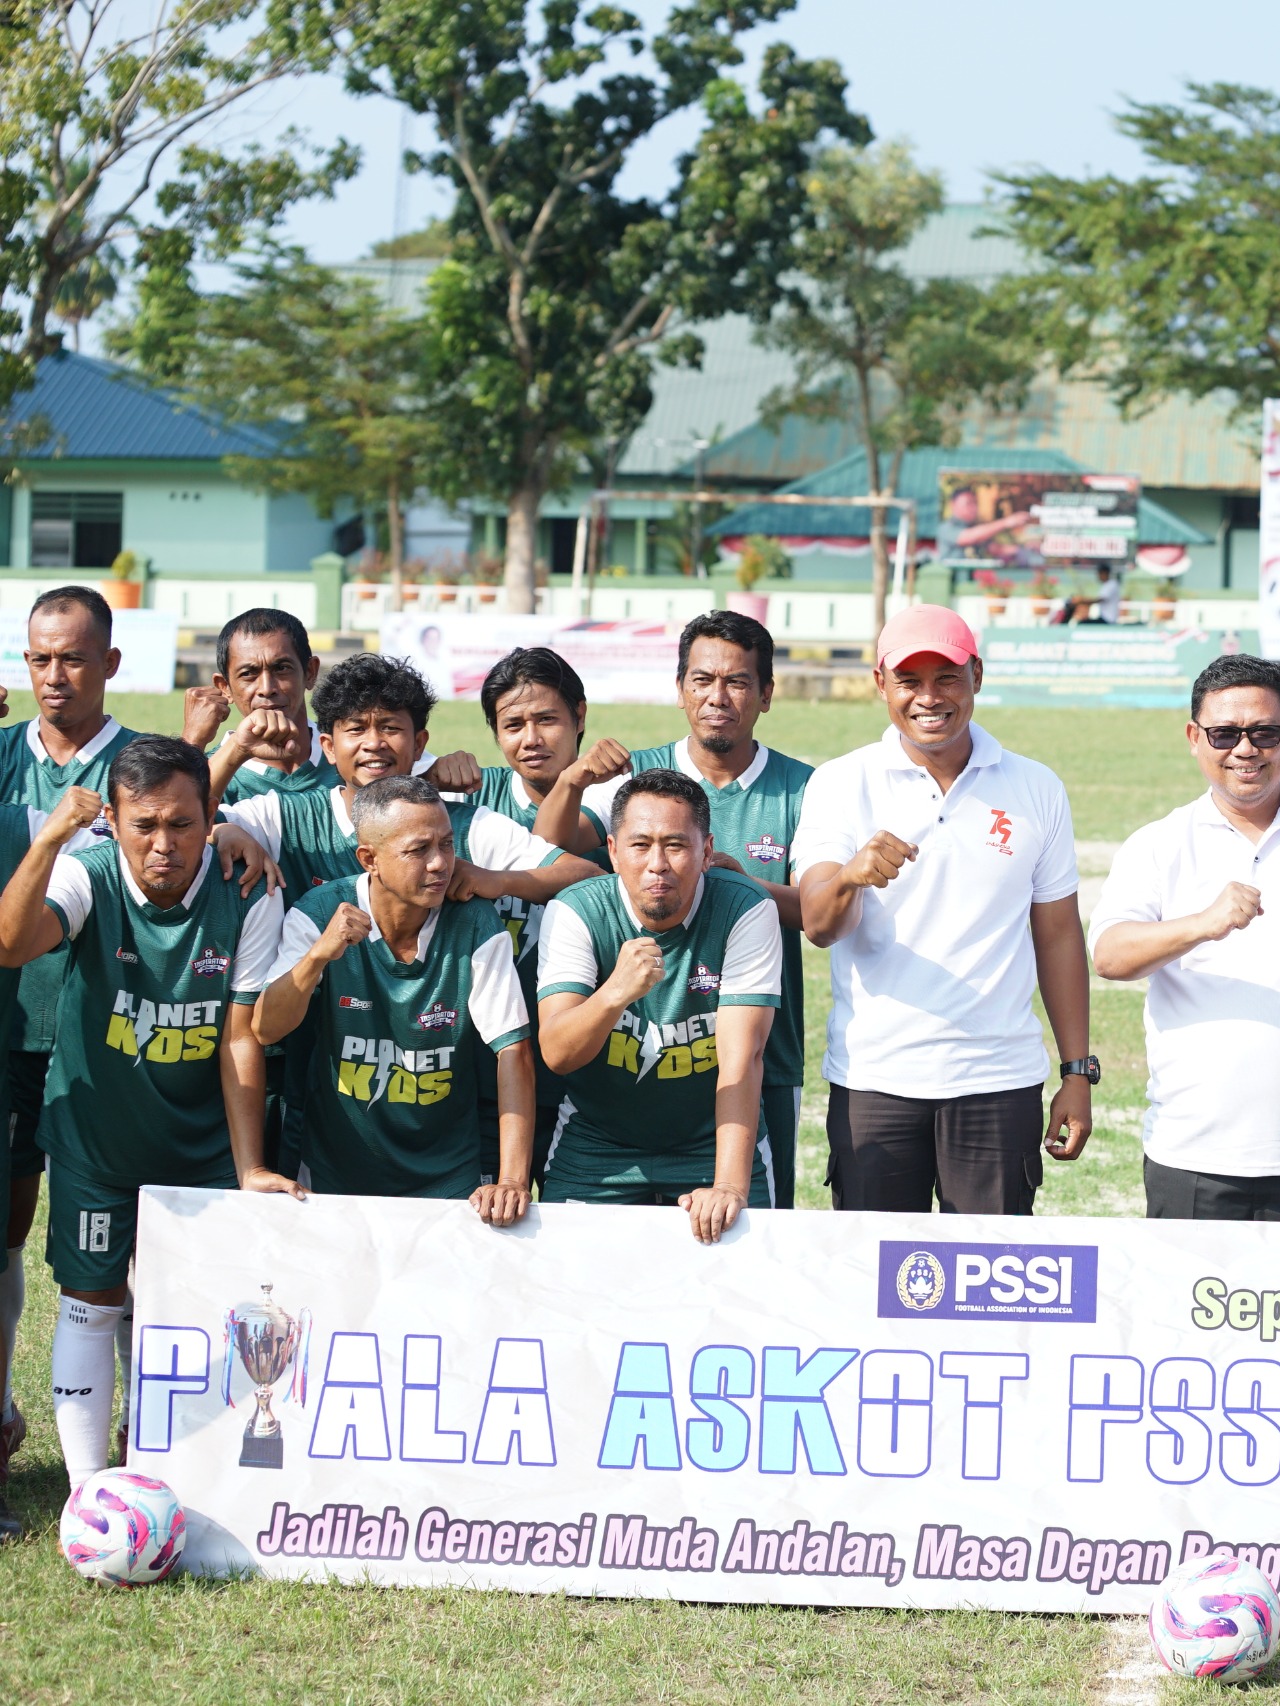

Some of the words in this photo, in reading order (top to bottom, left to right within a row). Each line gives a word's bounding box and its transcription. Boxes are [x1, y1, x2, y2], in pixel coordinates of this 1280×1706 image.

[341, 1035, 456, 1071] PLANET
[79, 1211, 111, 1252] 18
[954, 1253, 1073, 1305] PSSI
[954, 1304, 986, 1313] FOOTBALL
[986, 1305, 1028, 1314] ASSOCIATION
[1029, 1306, 1038, 1314] OF
[1038, 1307, 1073, 1315] INDONESIA
[135, 1324, 558, 1467] PALA
[596, 1341, 1030, 1481] ASKOT
[257, 1501, 409, 1560] Jadilah
[417, 1505, 597, 1567] Generasi
[598, 1514, 720, 1573] Muda
[724, 1518, 903, 1587] Andalan,
[914, 1523, 1030, 1582] Masa
[1038, 1527, 1170, 1594] Depan
